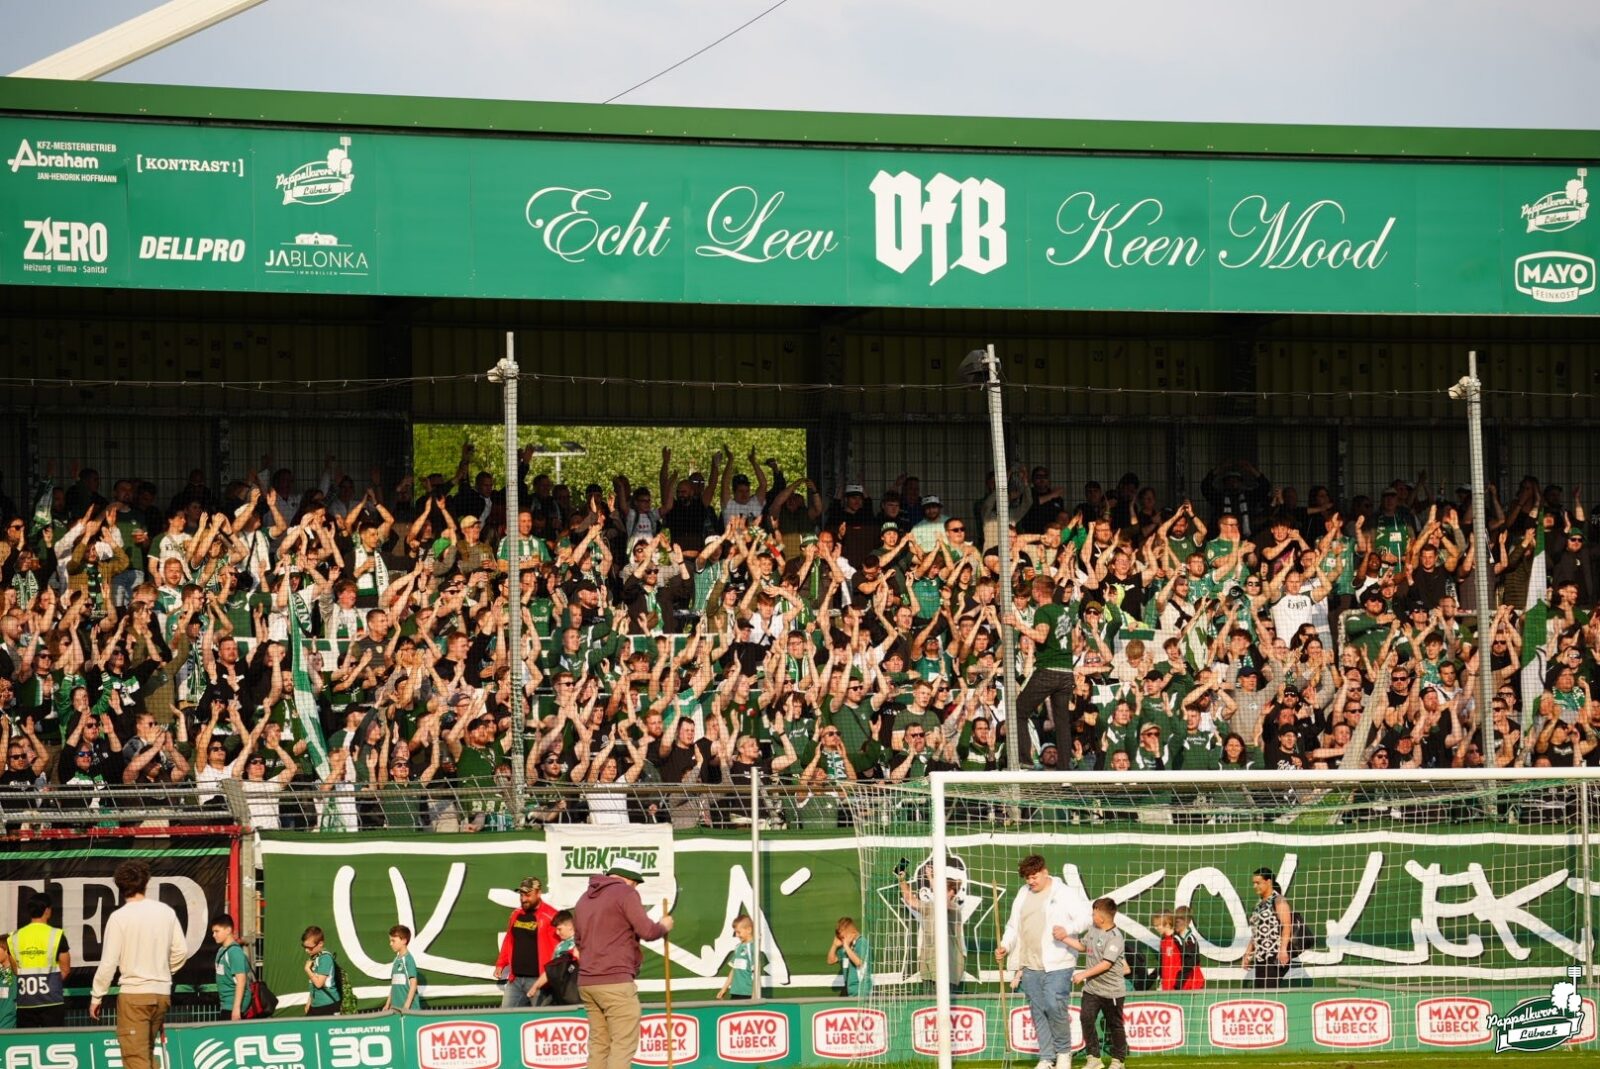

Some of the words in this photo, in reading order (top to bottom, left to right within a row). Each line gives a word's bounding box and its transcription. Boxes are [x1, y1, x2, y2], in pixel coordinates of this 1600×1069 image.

[37, 141, 117, 153] KFZ-MEISTERBETRIEB
[7, 138, 99, 173] Abraham
[37, 172, 81, 182] JAN-HENDRIK
[81, 173, 117, 183] HOFFMANN
[303, 184, 333, 196] Lübeck
[525, 186, 672, 264] Echt
[695, 185, 839, 264] Leev
[868, 169, 1008, 286] VfB
[1045, 190, 1206, 269] Keen
[1218, 194, 1397, 270] Mood
[138, 235, 247, 263] DELLPRO
[263, 249, 370, 269] JABLONKA
[23, 263, 52, 273] Heizung
[57, 264, 77, 273] Klima
[82, 265, 108, 274] Sanitär
[1523, 263, 1588, 285] MAYO
[1535, 289, 1575, 300] FEINKOST
[18, 976, 50, 996] 305
[1221, 1008, 1275, 1024] MAYO
[1325, 1006, 1379, 1022] MAYO
[1428, 1005, 1480, 1021] MAYO
[729, 1019, 777, 1036] MAYO
[825, 1016, 875, 1032] MAYO
[924, 1013, 973, 1030] MYO
[1222, 1023, 1275, 1036] LÜBECK
[1326, 1022, 1378, 1035] LÜBECK
[1429, 1020, 1480, 1033] LÜBECK
[328, 1025, 391, 1036] CELEBRATING
[431, 1029, 486, 1047] MAYO
[534, 1026, 588, 1043] MAYO
[825, 1032, 875, 1045] LÜBECK
[925, 1029, 973, 1043] LÜECK
[1126, 1026, 1171, 1039] ÜBECK
[233, 1034, 305, 1065] FLS
[535, 1043, 588, 1057] LÜBECK
[729, 1035, 777, 1049] LÜBECK
[329, 1035, 392, 1068] 30
[432, 1046, 487, 1061] LÜBECK
